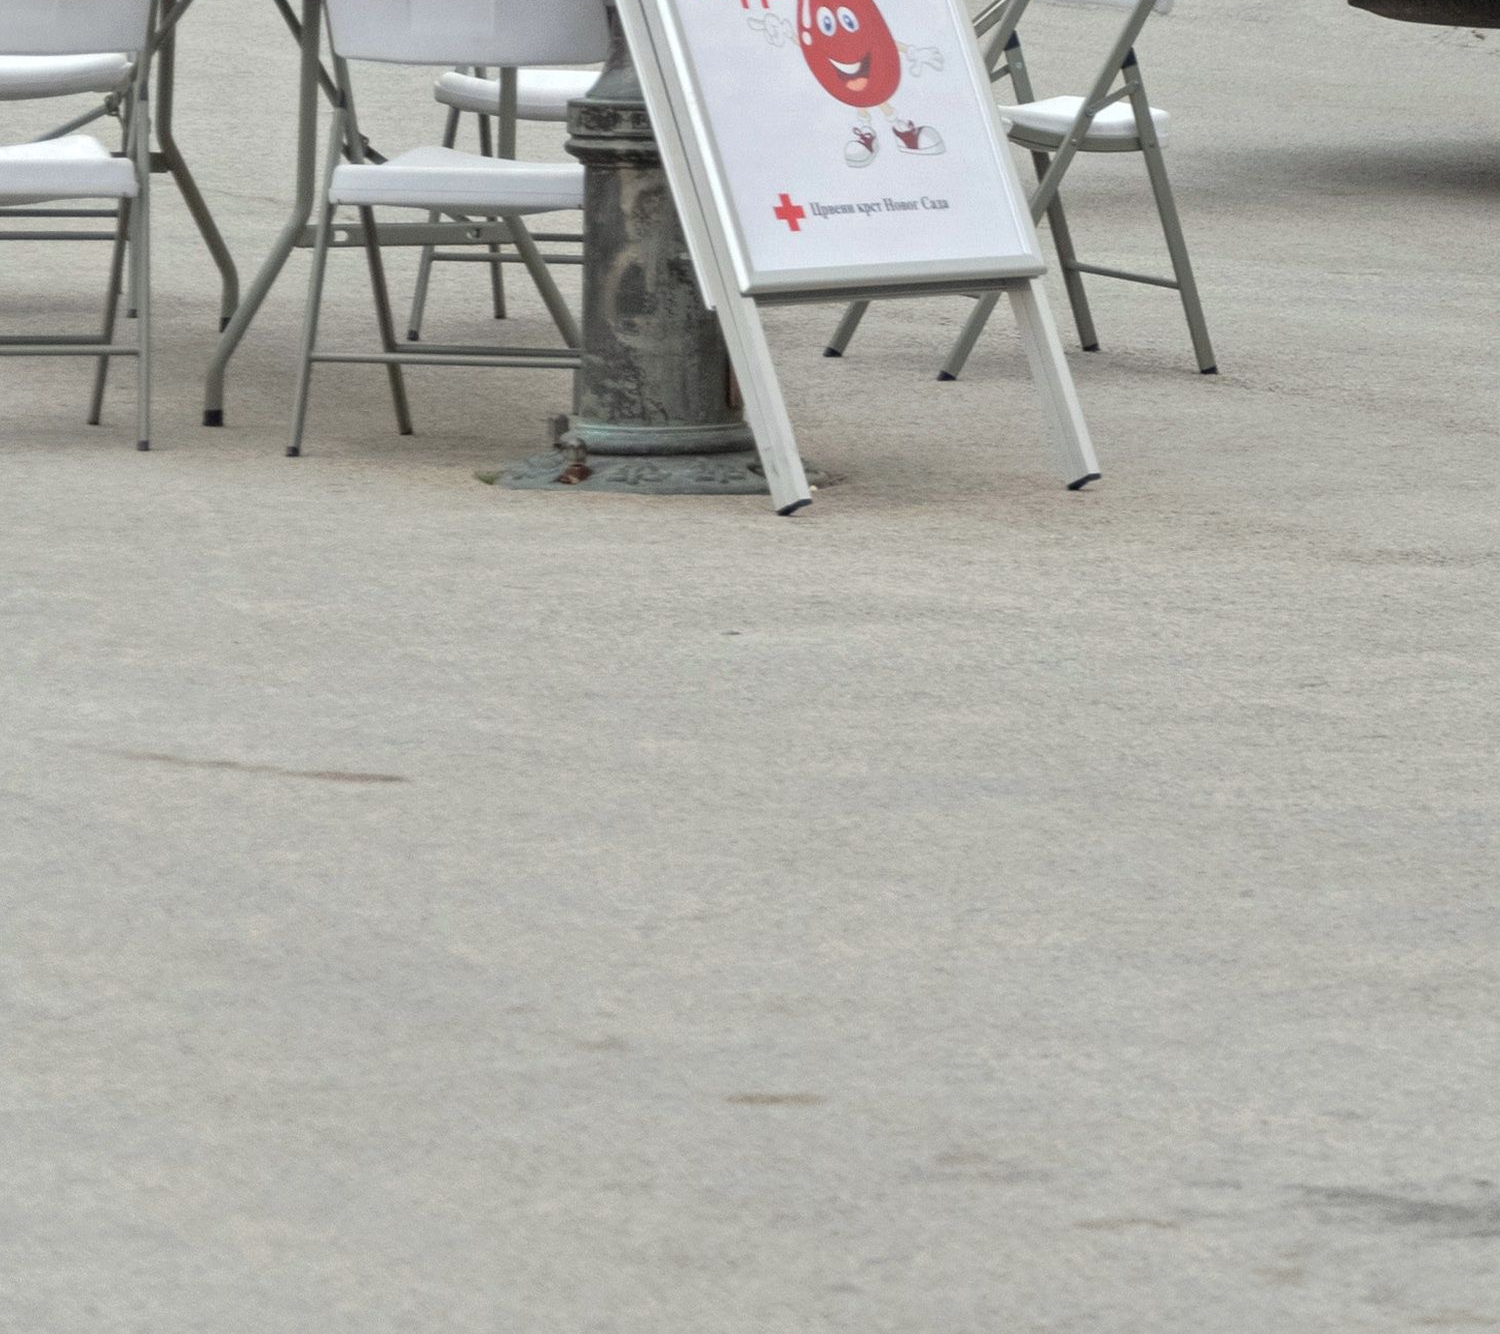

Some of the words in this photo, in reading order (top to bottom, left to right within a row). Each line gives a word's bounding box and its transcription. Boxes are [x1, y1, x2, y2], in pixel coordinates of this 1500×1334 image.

[809, 201, 855, 219] Црвени
[856, 201, 882, 217] крст
[883, 197, 919, 212] Новог
[920, 195, 950, 211] Сада
